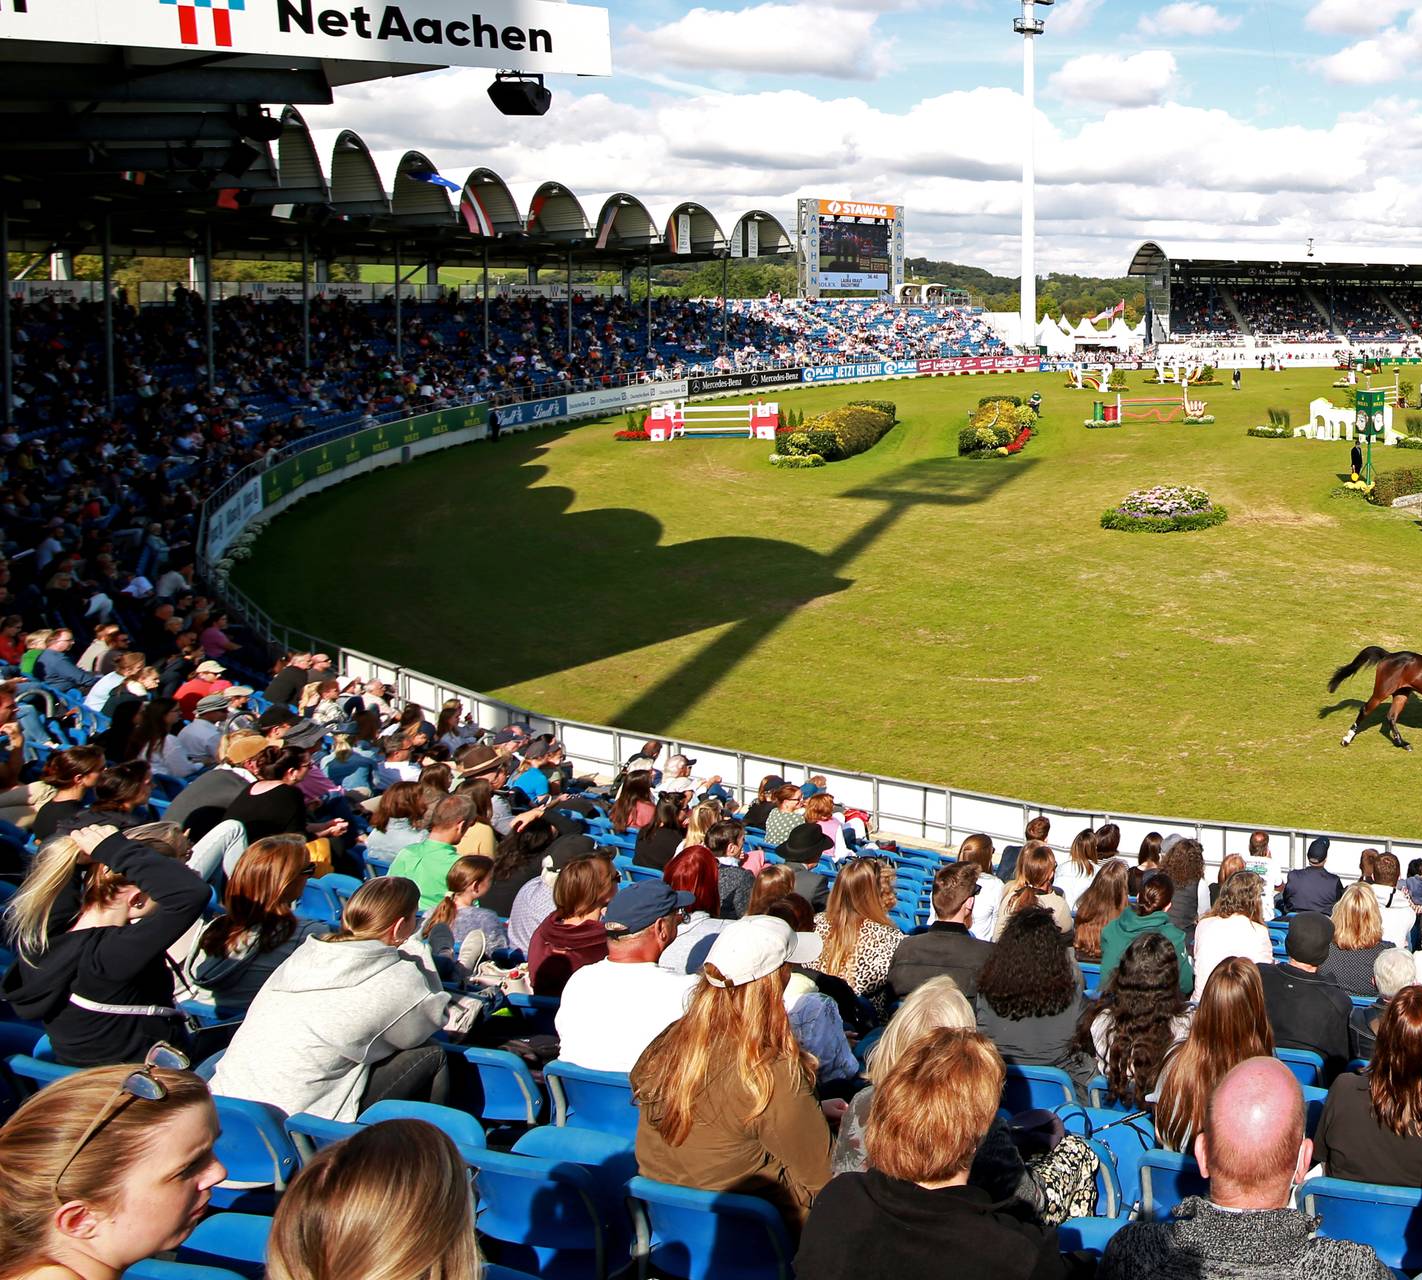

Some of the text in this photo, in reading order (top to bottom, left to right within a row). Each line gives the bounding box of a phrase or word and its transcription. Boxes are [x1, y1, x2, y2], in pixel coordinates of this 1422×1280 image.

[277, 0, 553, 54] NetAachen
[842, 203, 887, 217] STAWAG
[815, 367, 834, 375] PLAN
[836, 363, 881, 377] JETZT HELFEN!
[897, 360, 917, 369] PLAN
[701, 378, 743, 390] Mercedes-Benz
[760, 372, 799, 383] Mercedes-Benz
[532, 403, 554, 419] Lindt
